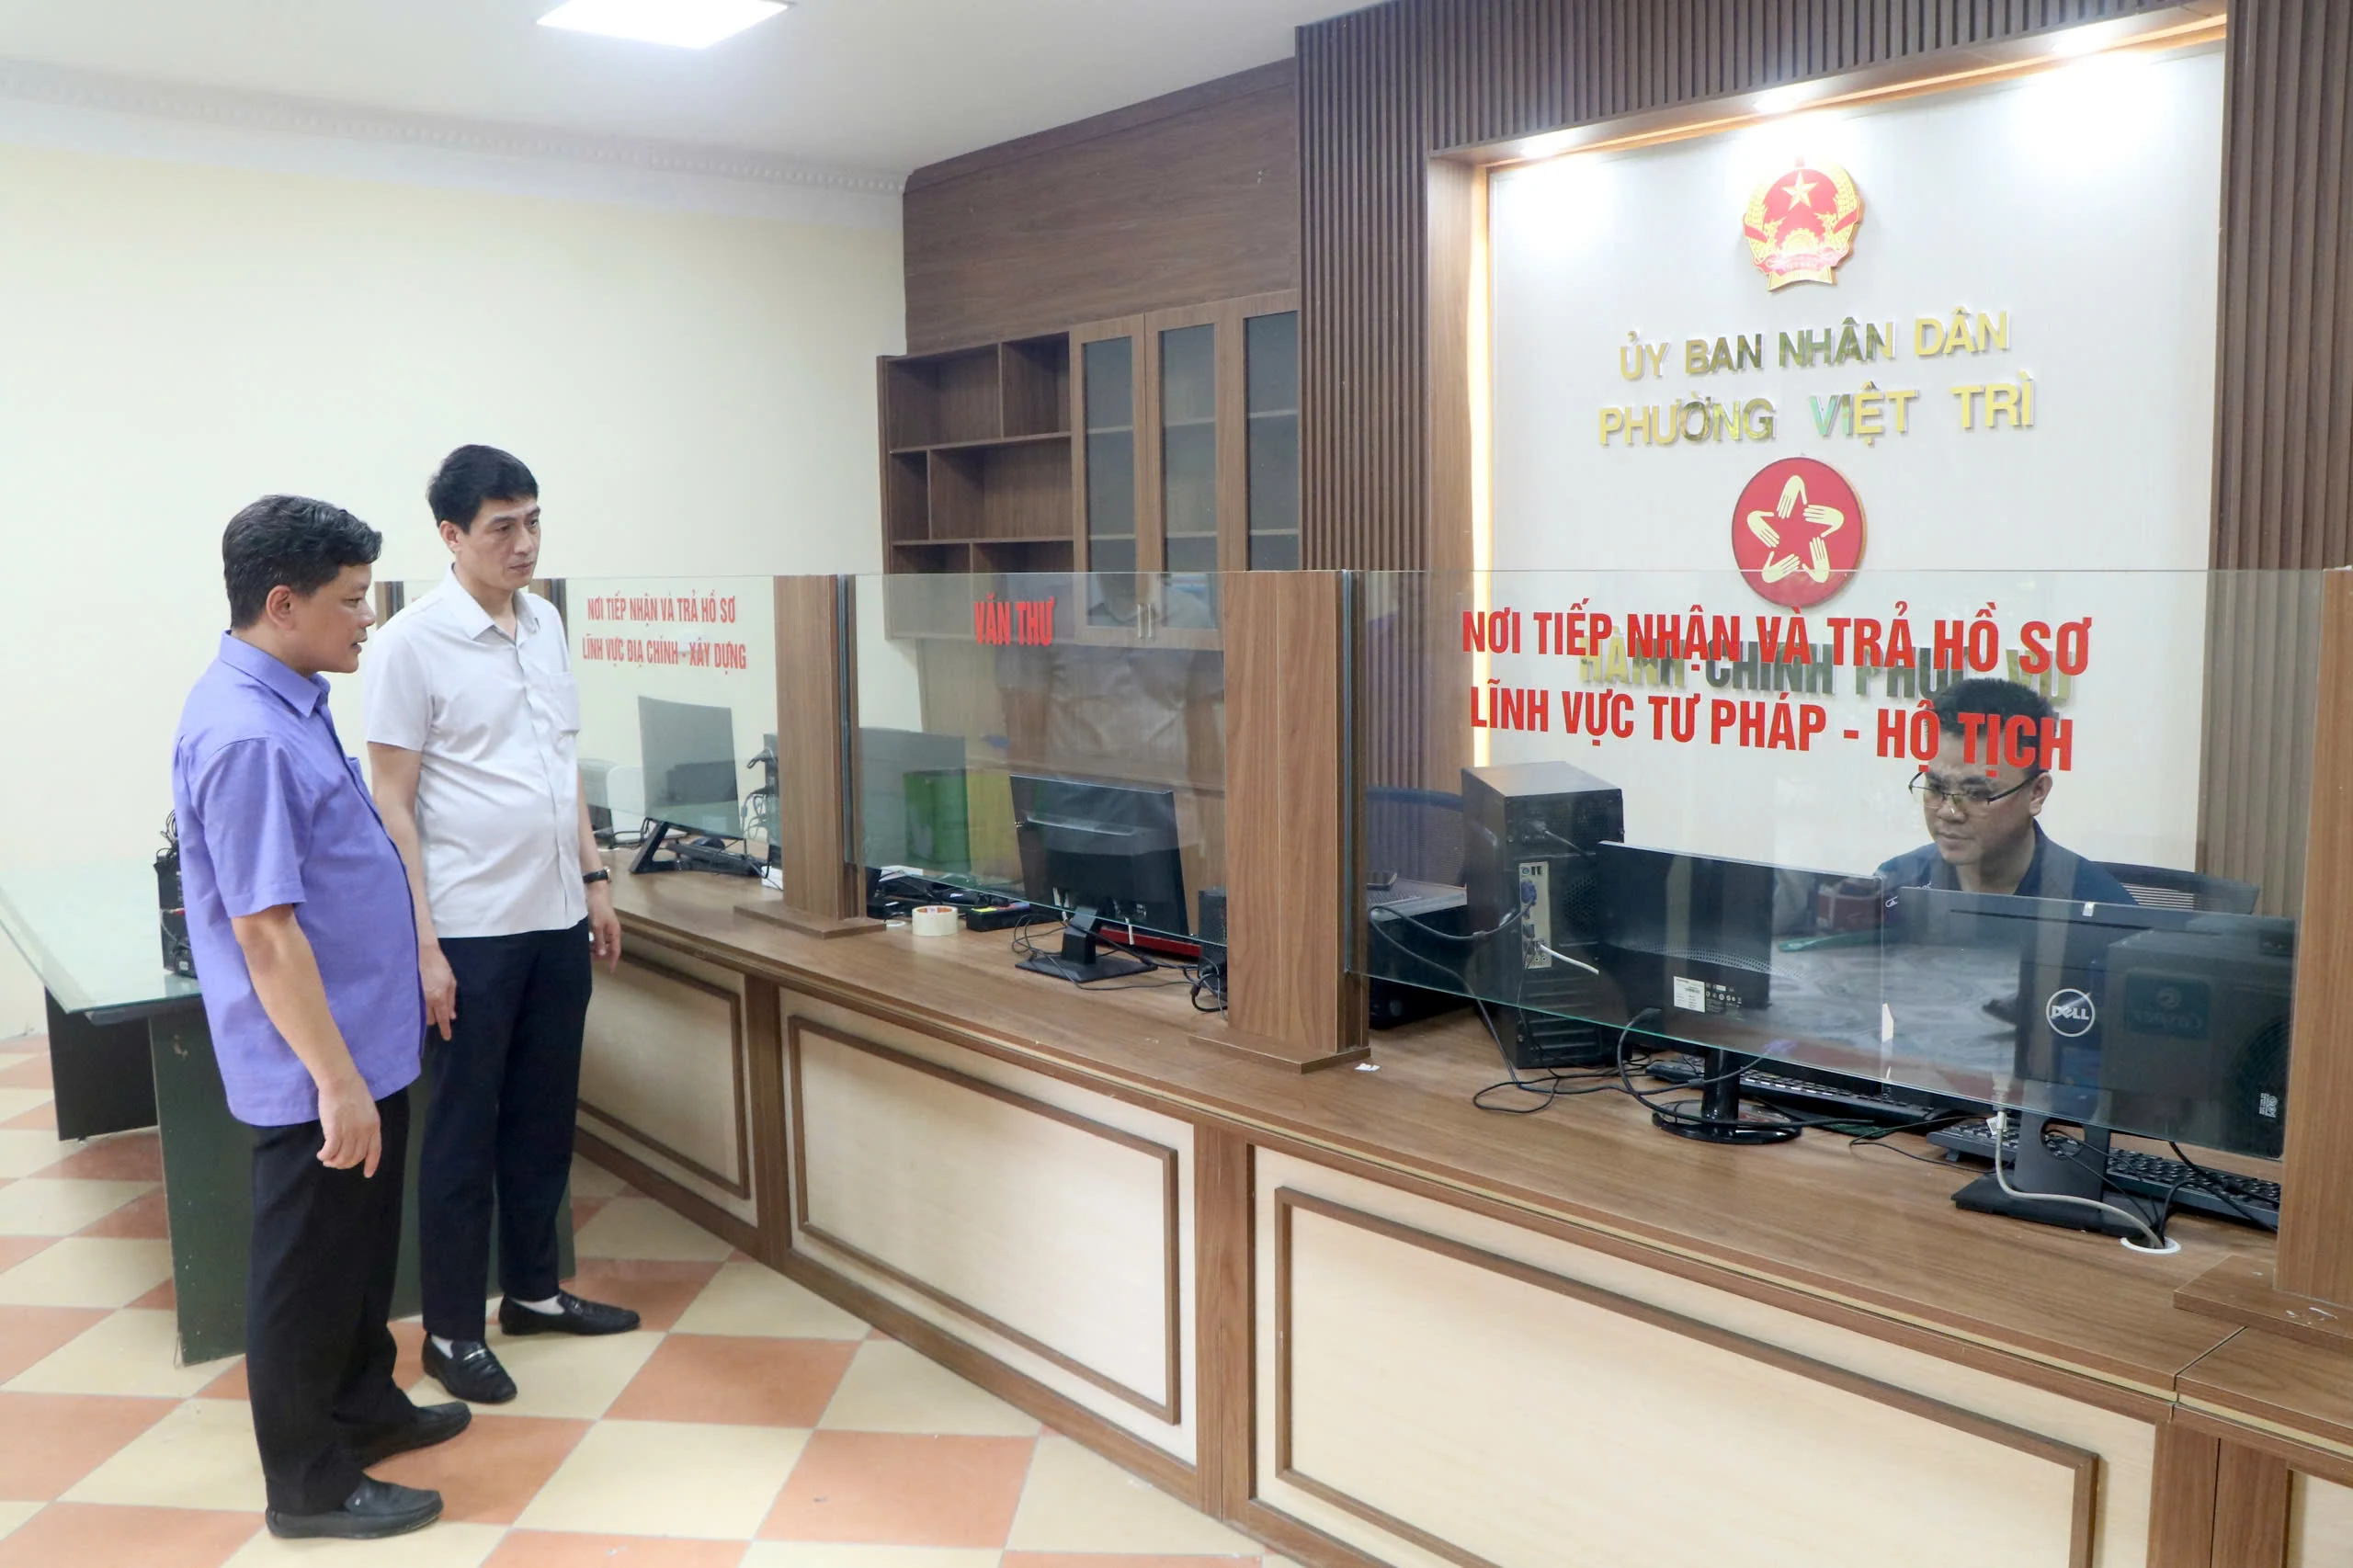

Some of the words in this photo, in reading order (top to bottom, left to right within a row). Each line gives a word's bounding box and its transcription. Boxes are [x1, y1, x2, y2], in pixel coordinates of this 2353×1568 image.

[1620, 330, 1669, 381] ỦY
[1685, 333, 1763, 374] BAN
[1779, 316, 1895, 369] NHÂN
[1914, 306, 2007, 357] DÂN
[1599, 390, 1776, 447] PHƯỜNG
[1808, 381, 1918, 446] VIỆT
[1950, 370, 2033, 429] TRÌ
[587, 595, 604, 621] NƠI
[606, 590, 627, 621] TIẾP
[630, 593, 658, 627] NHẬN
[660, 592, 675, 622] VÀ
[676, 589, 699, 623] TRẢ
[720, 595, 735, 624] SƠ
[973, 592, 1011, 646] VĂN
[1015, 595, 1055, 647] THƯ
[1462, 607, 1521, 653] NƠI
[1532, 597, 1613, 656] TIẾP
[1627, 604, 1741, 672] NHẬN
[1756, 606, 1812, 665] VÀ
[1827, 599, 1916, 669] TRẢ
[1934, 601, 1999, 673] HỒ
[2018, 617, 2093, 676] SƠ
[582, 632, 603, 661] LĨNH
[606, 636, 624, 667] VỰC
[646, 635, 678, 665] CHÍNH
[688, 636, 710, 667] XÂY
[714, 641, 747, 676] DỰNG
[1471, 678, 1549, 733] LĨNH
[1562, 688, 1634, 746] VỰC
[1648, 693, 1700, 743] TƯ
[1711, 692, 1826, 752] PHÁP
[1844, 729, 1859, 739] -
[1877, 699, 1940, 773] HỘ
[1958, 711, 2074, 778] TỊCH
[2051, 1005, 2089, 1020] DELL
